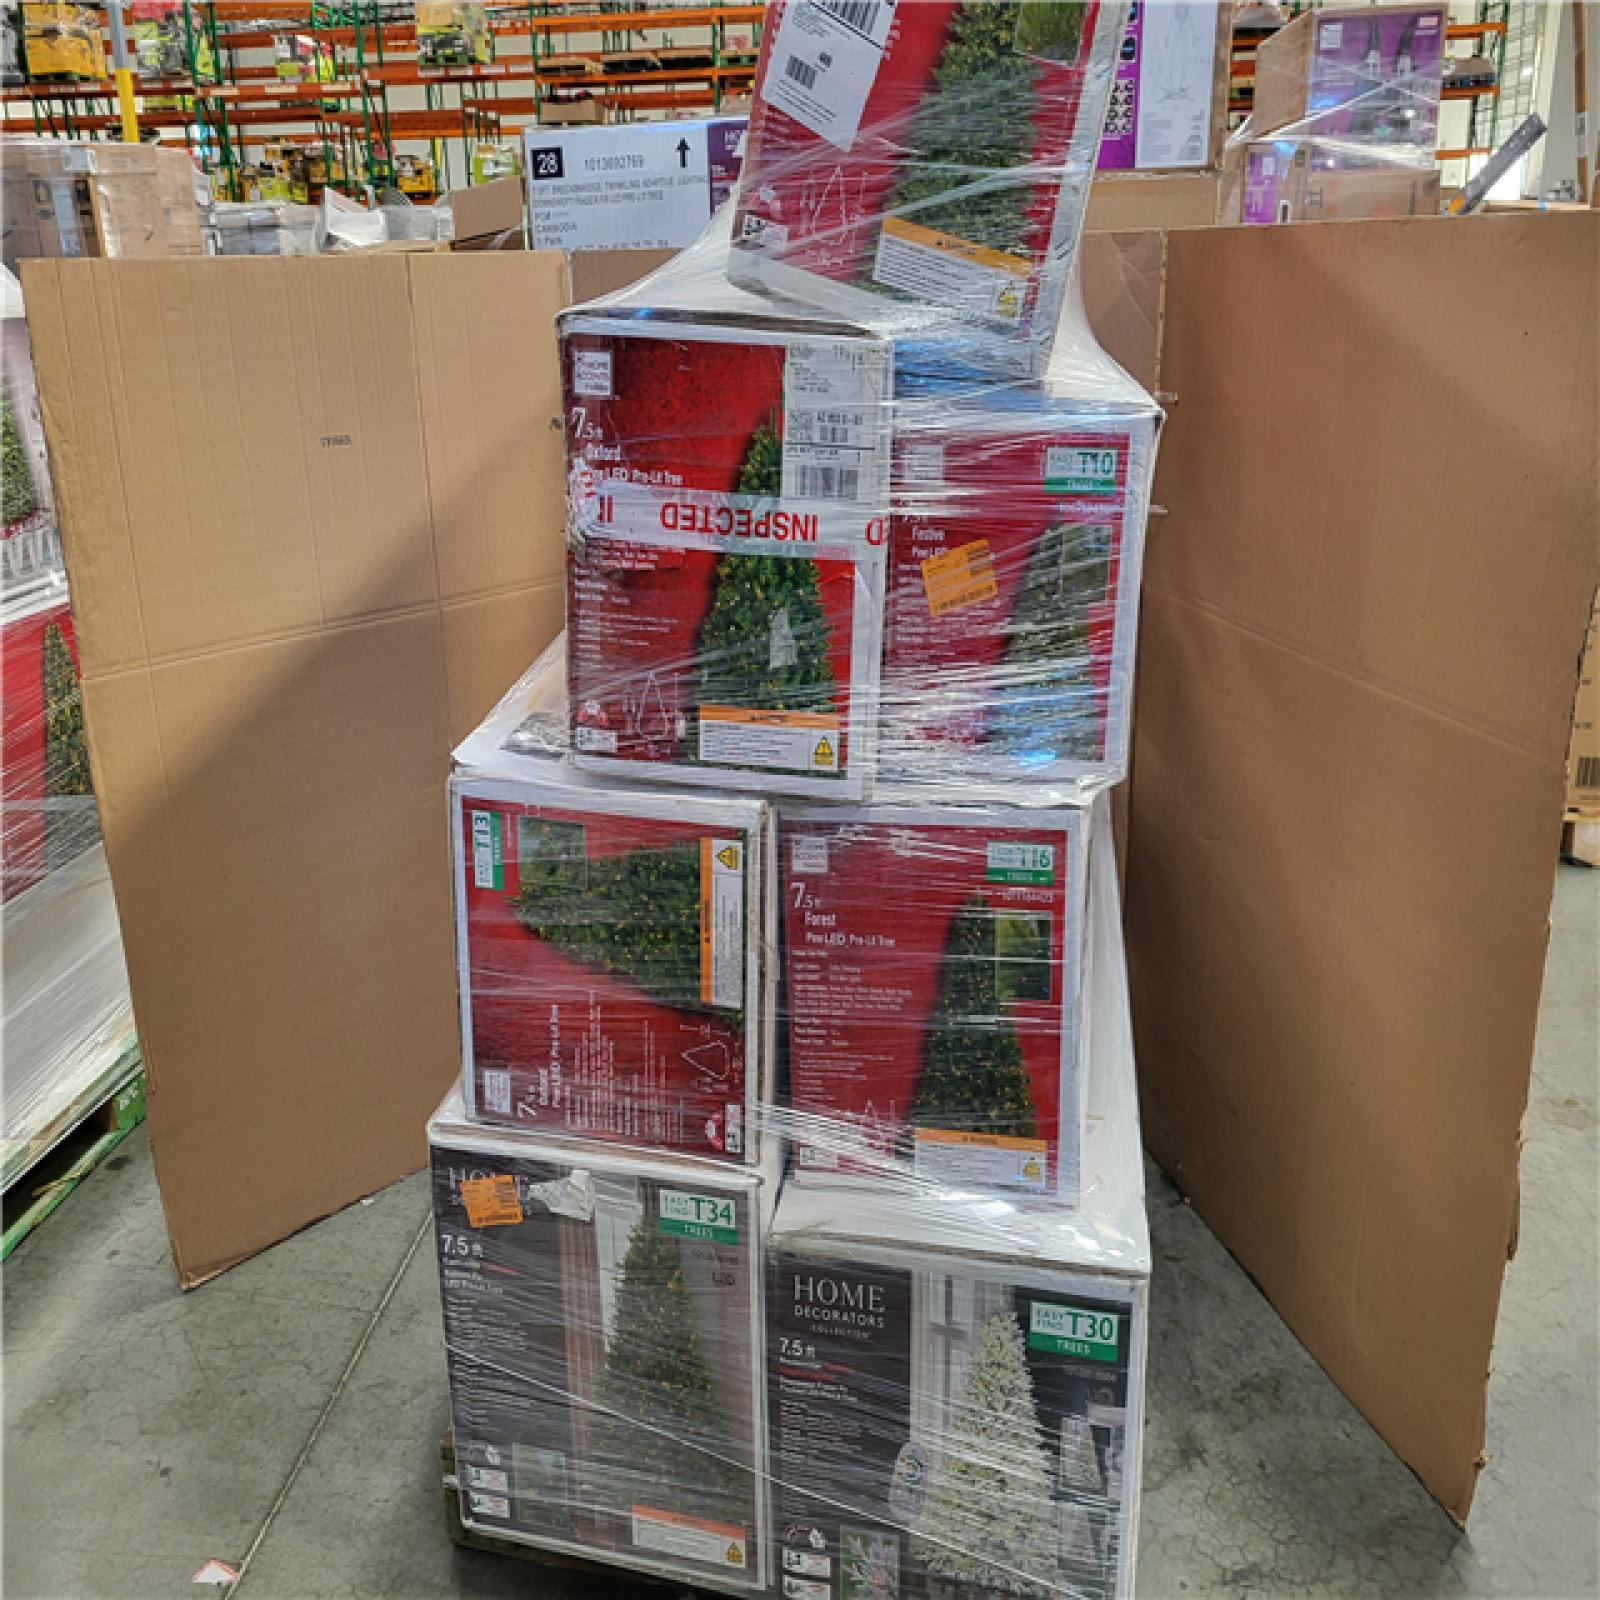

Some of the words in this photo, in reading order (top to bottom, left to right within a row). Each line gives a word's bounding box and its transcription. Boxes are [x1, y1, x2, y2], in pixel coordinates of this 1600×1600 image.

[536, 153, 559, 174] 28
[1078, 451, 1114, 475] T10
[660, 501, 818, 542] INSPECTED
[689, 1196, 733, 1226] T34
[442, 1234, 469, 1256] 7.5
[794, 1273, 886, 1313] HOME
[794, 1304, 885, 1329] DECORATORS
[1065, 1310, 1114, 1341] T30
